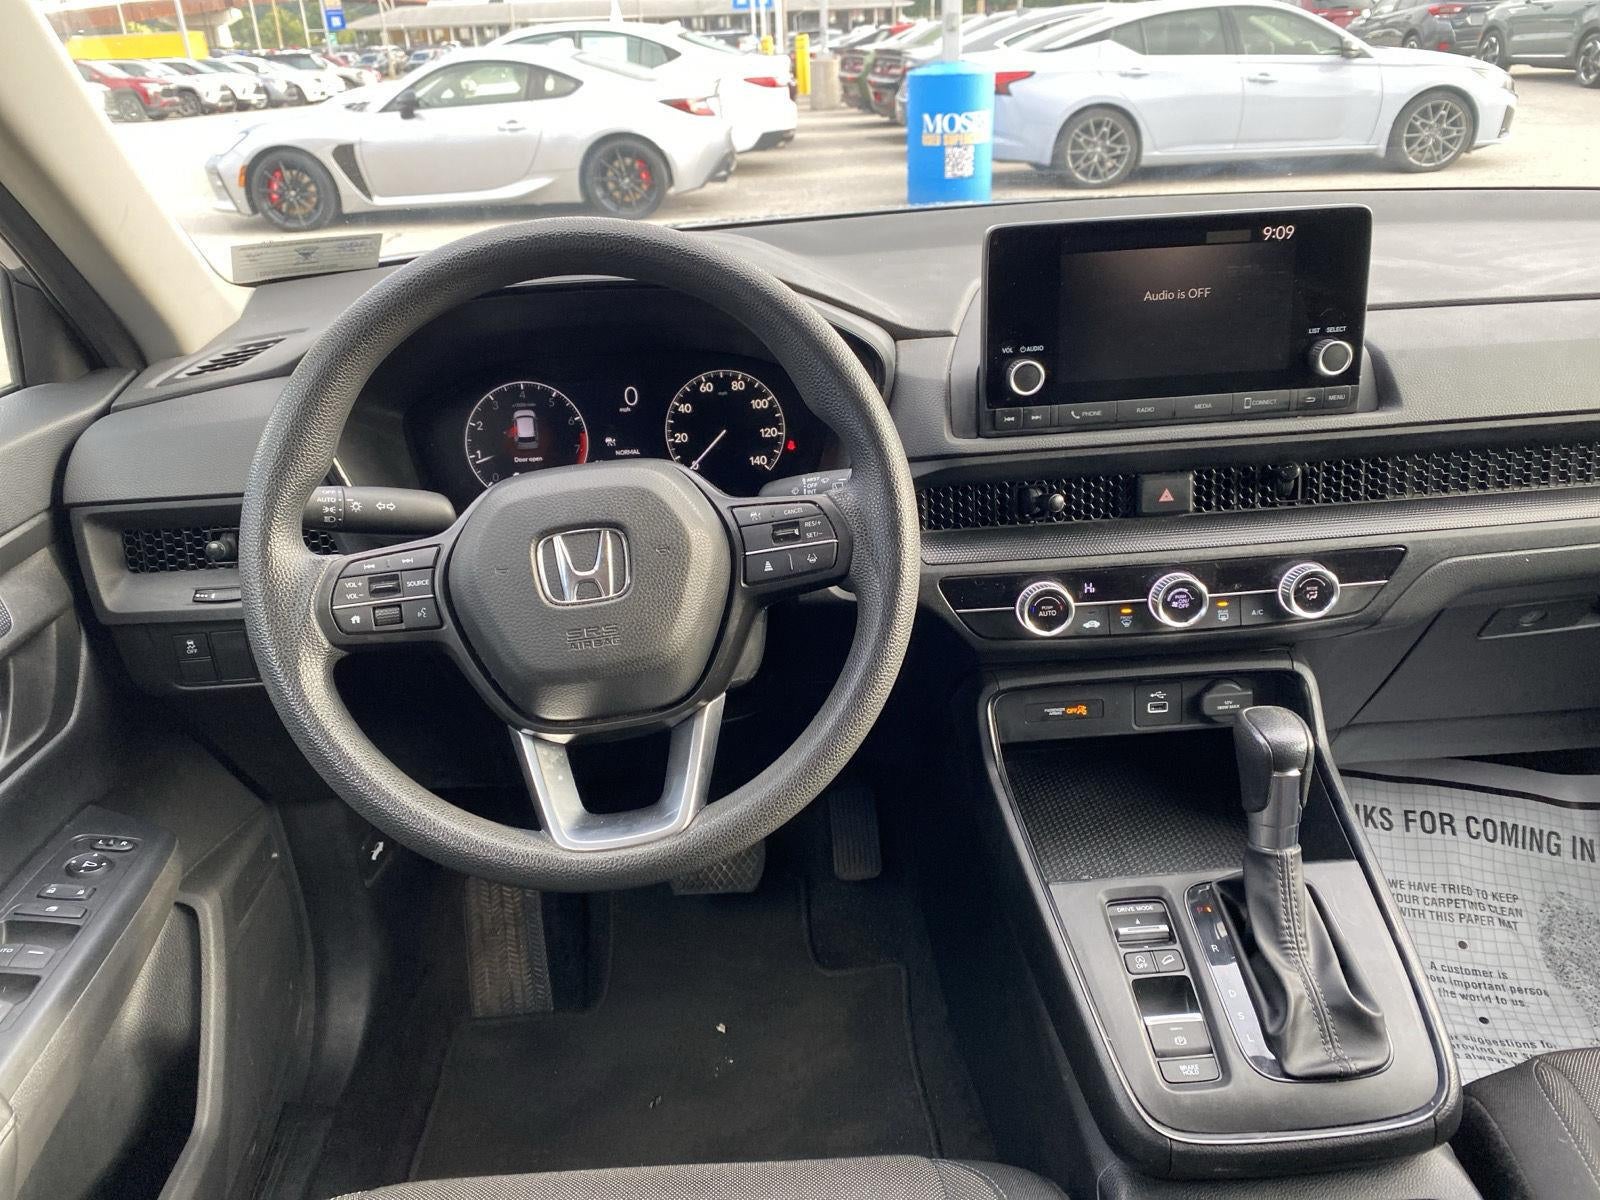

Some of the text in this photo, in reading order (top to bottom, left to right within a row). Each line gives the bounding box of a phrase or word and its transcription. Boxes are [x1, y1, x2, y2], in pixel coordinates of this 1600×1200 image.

[1263, 225, 1295, 241] 9:09
[1143, 287, 1212, 301] Audio is OFF
[1326, 325, 1347, 333] SELECT
[700, 382, 714, 392] 60
[731, 380, 745, 391] 80
[519, 390, 526, 399] 4
[493, 401, 499, 410] 3
[548, 398, 555, 407] 5
[750, 399, 769, 409] 100
[678, 403, 692, 413] 40
[568, 416, 575, 425] 6
[476, 421, 484, 431] 2
[760, 427, 778, 438] 120
[674, 433, 688, 443] 20
[574, 444, 580, 454] 7
[476, 450, 481, 459] 1
[749, 455, 768, 465] 140
[783, 507, 804, 515] CANCEL
[406, 579, 430, 587] SOURCE
[570, 637, 620, 650] AIRBAG
[1403, 809, 1457, 836] FOR
[1465, 815, 1562, 857] COMING
[1572, 836, 1596, 863] IN
[1388, 878, 1519, 904] WE HAVE TRIED TO KEEP
[1423, 896, 1486, 912] CARPETING
[1488, 904, 1523, 918] CLEAN
[1428, 910, 1455, 923] THIS
[1459, 912, 1495, 927] PAPER
[1211, 944, 1220, 952] R
[1430, 961, 1508, 980] A customer is
[1449, 977, 1506, 992] important
[1229, 989, 1236, 998] D
[1460, 992, 1492, 1003] world
[1495, 996, 1507, 1005] to
[1238, 1012, 1245, 1020] S
[1247, 1034, 1254, 1042] L
[1463, 1035, 1538, 1049] suggestions
